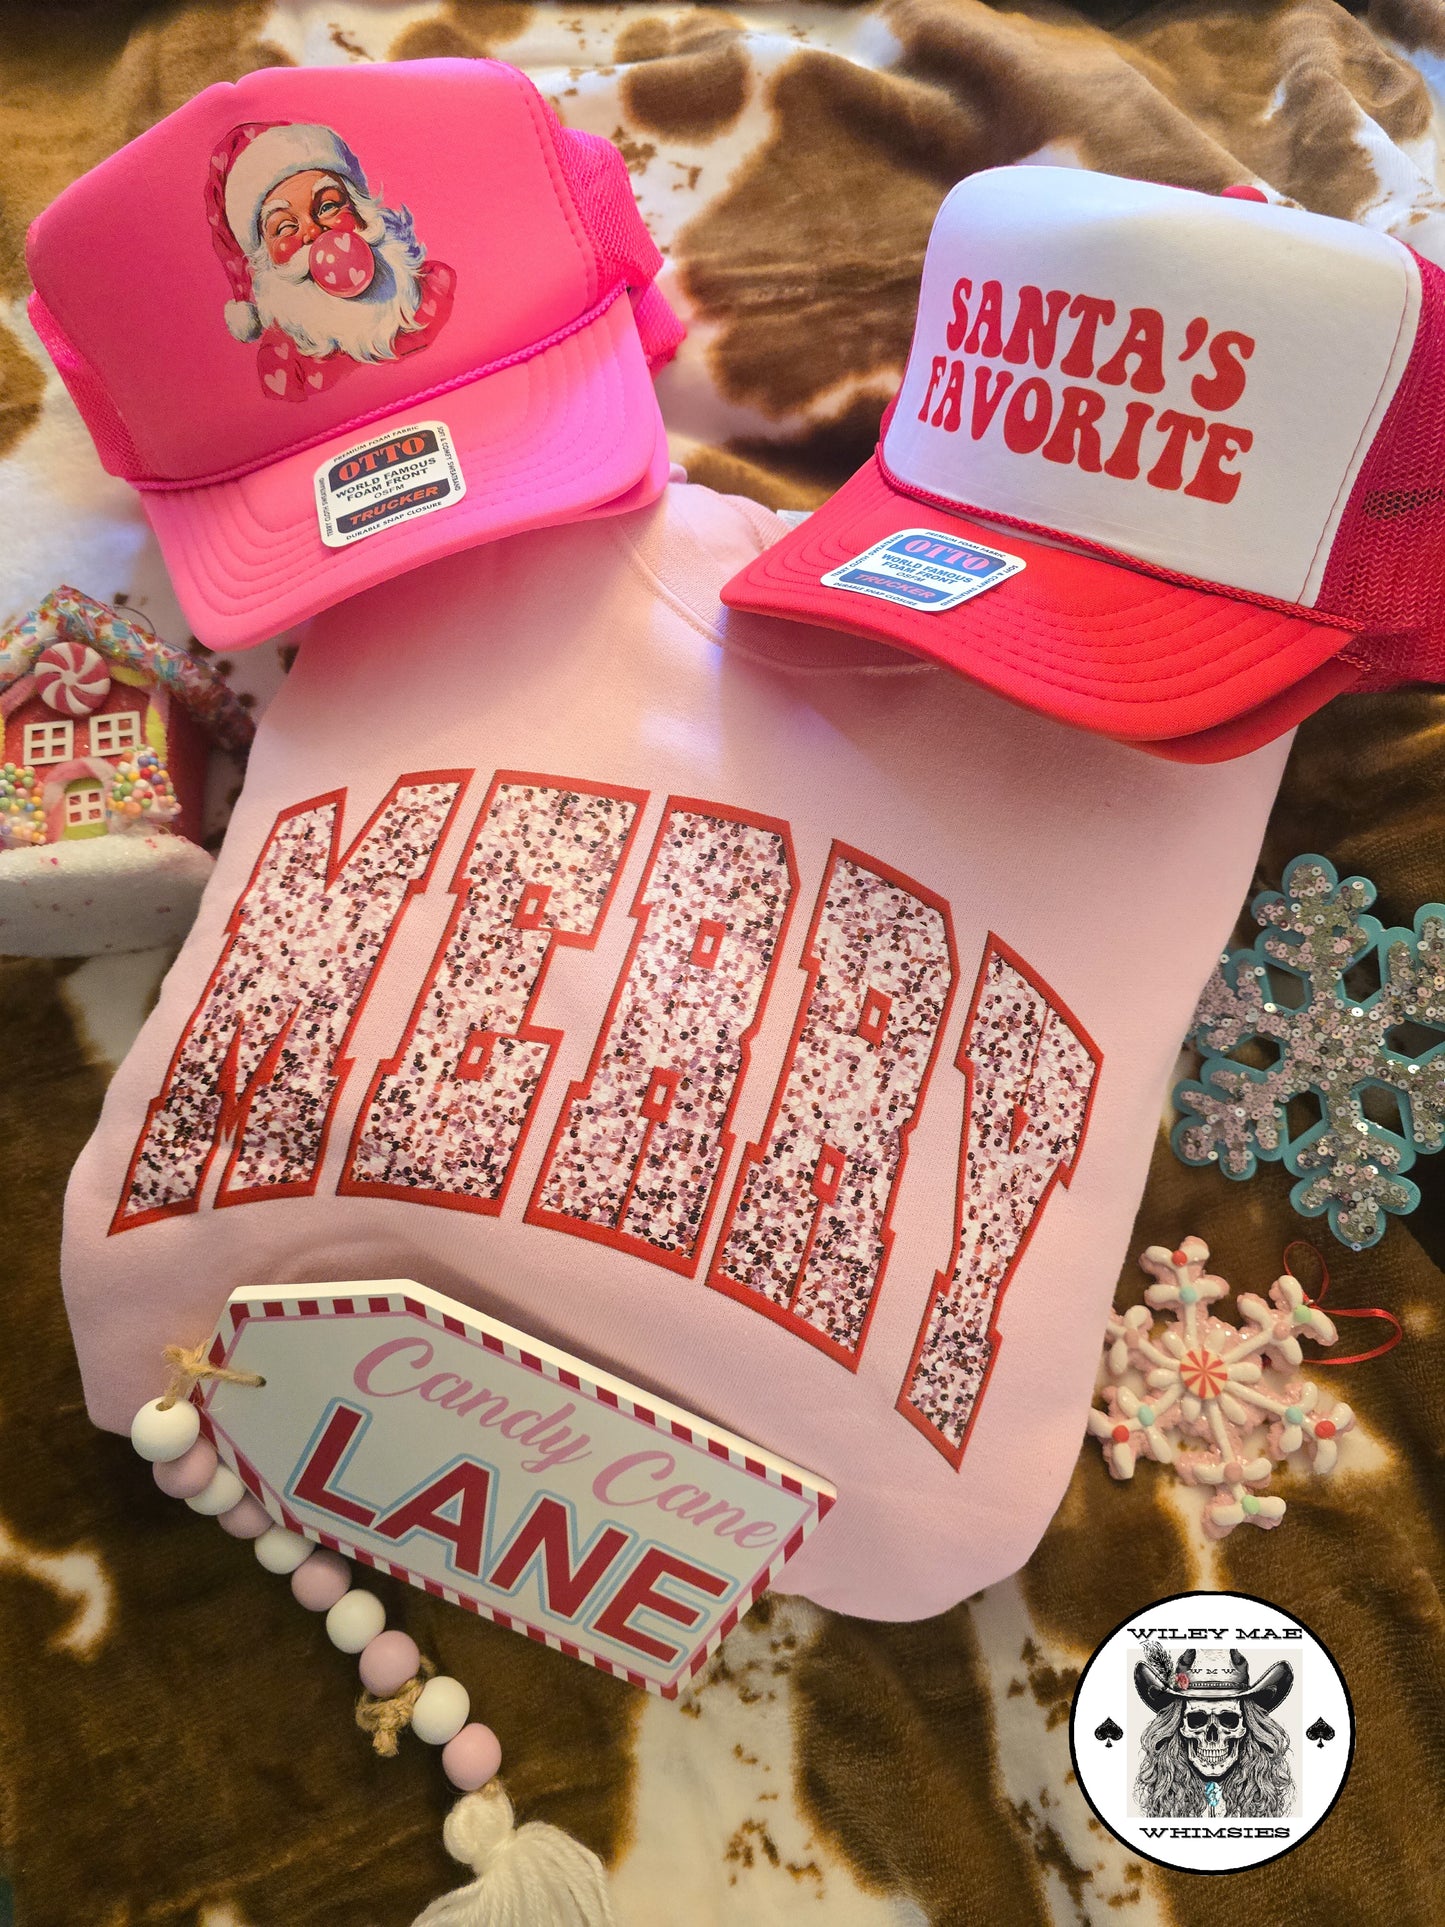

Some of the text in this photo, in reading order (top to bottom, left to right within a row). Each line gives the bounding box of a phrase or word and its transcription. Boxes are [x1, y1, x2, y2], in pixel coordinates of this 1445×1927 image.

[945, 277, 1256, 412] SANTA'S
[333, 425, 419, 462] PREMIUM FOAM FABRIC
[917, 355, 1254, 505] FAVORITE
[335, 457, 437, 498] WORLD FAMOUS
[338, 436, 425, 482] OTTO
[442, 442, 452, 460] COMFY
[447, 461, 461, 492] SWEATBAND
[347, 467, 429, 502] FOAM FRONT
[374, 483, 405, 499] OSFM
[346, 501, 442, 540] DURABLE SNAP CLOSURE
[349, 486, 439, 526] TRUCKER
[904, 539, 990, 571] OTTO
[925, 531, 1006, 558] PREMIUM FOAM FABRIC
[854, 573, 936, 599] TRUCKER
[881, 553, 974, 583] WORLD FAMOUS
[881, 561, 959, 585] FOAM FRONT
[895, 571, 926, 583] OSFM
[833, 582, 918, 606] DURABLE SNAP CLOSURE
[107, 767, 1105, 1470] MERRY
[352, 1335, 778, 1551] Candy Cane
[289, 1400, 735, 1667] LANE
